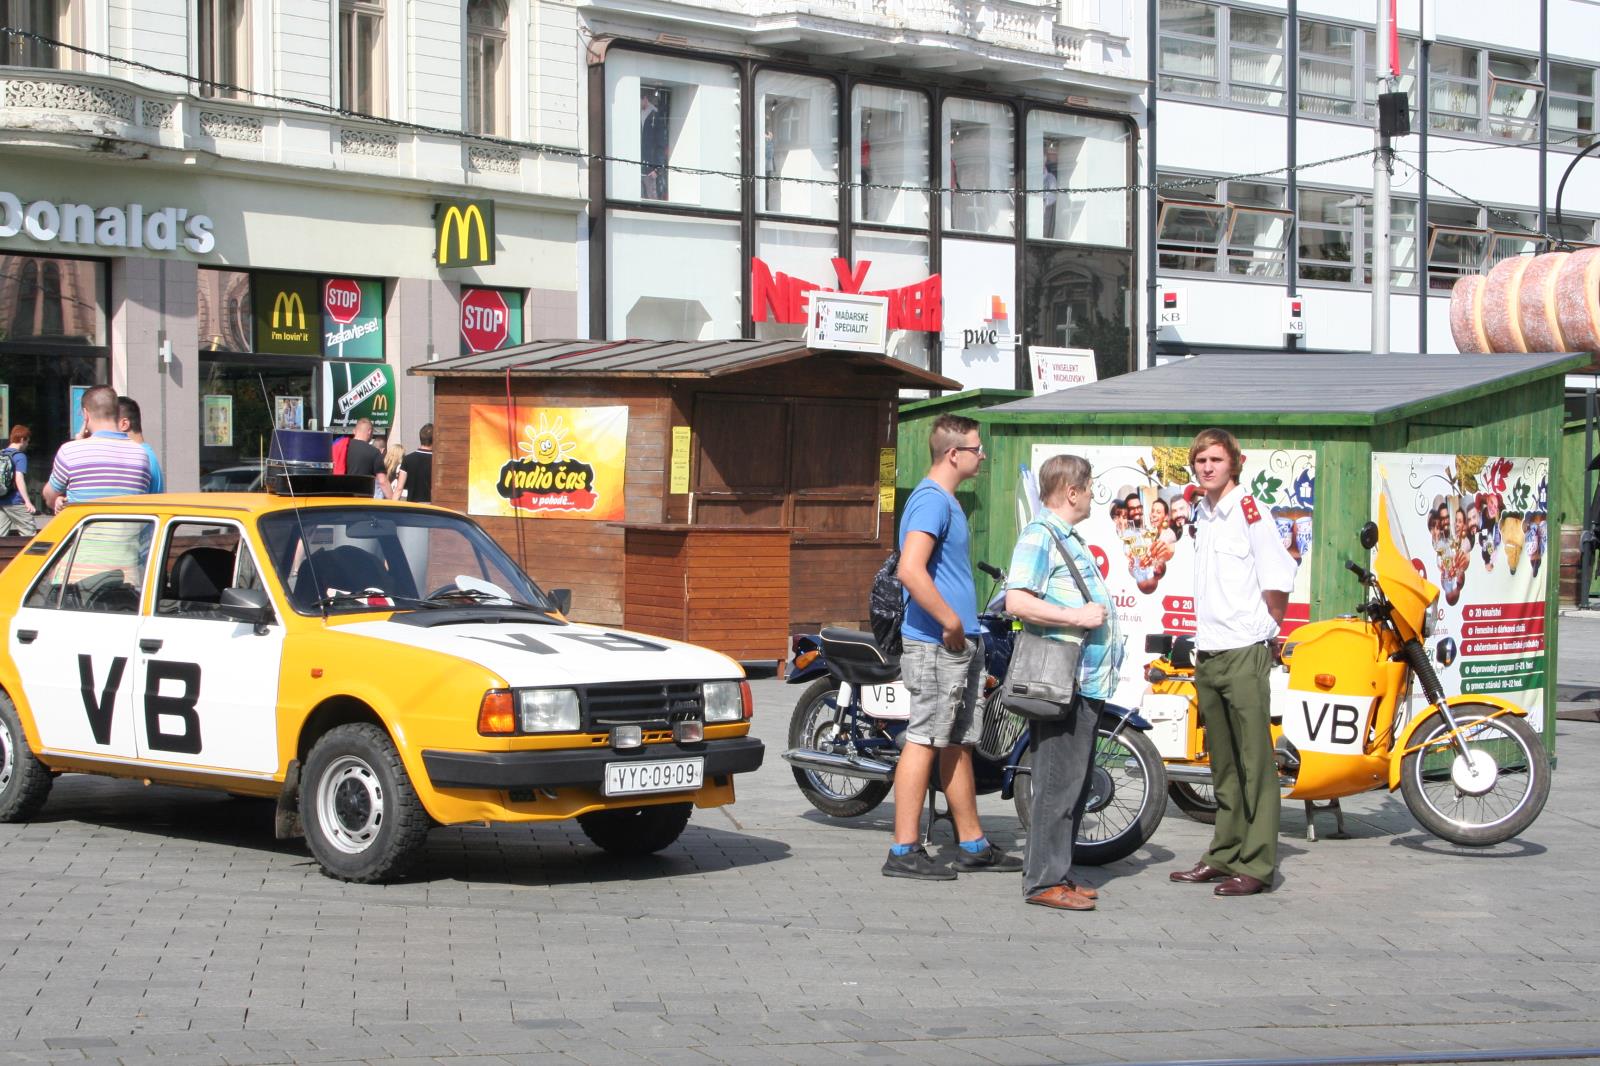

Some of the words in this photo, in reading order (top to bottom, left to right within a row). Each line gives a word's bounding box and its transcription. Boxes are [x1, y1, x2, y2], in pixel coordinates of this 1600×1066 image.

[329, 288, 358, 309] STOP
[464, 305, 503, 333] STOP
[834, 309, 869, 322] MAĎARSKÉ
[1161, 312, 1181, 322] KB
[834, 322, 869, 334] SPECIALITY
[1289, 321, 1304, 331] KB
[271, 331, 283, 340] i'm
[302, 333, 309, 342] it
[963, 327, 998, 349] pwc
[504, 465, 553, 490] radio
[554, 465, 587, 490] čas
[1182, 600, 1193, 610] 20
[873, 685, 896, 703] VB
[78, 654, 203, 755] VB
[1302, 700, 1359, 745] VB
